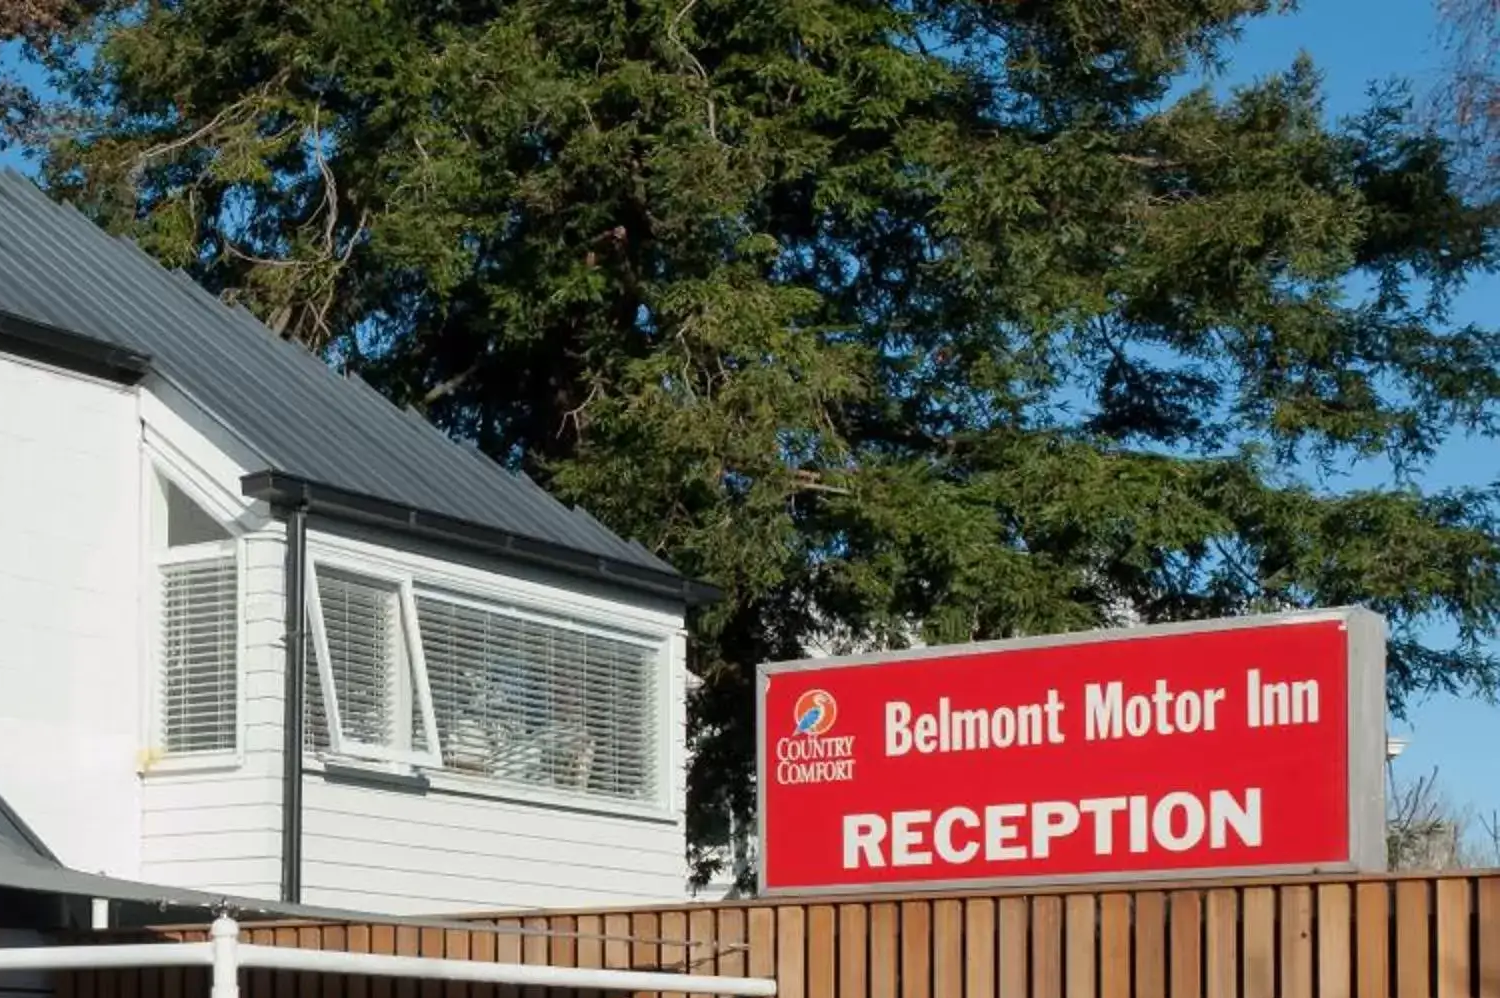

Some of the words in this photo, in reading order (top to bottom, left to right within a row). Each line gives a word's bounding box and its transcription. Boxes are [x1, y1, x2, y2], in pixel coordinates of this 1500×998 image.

[884, 689, 1065, 757] Belmont
[1084, 679, 1227, 742] Motor
[1247, 669, 1320, 728] Inn
[776, 735, 856, 761] COUNTRY
[776, 759, 856, 785] COMFORT
[842, 787, 1264, 870] RECEPTION
